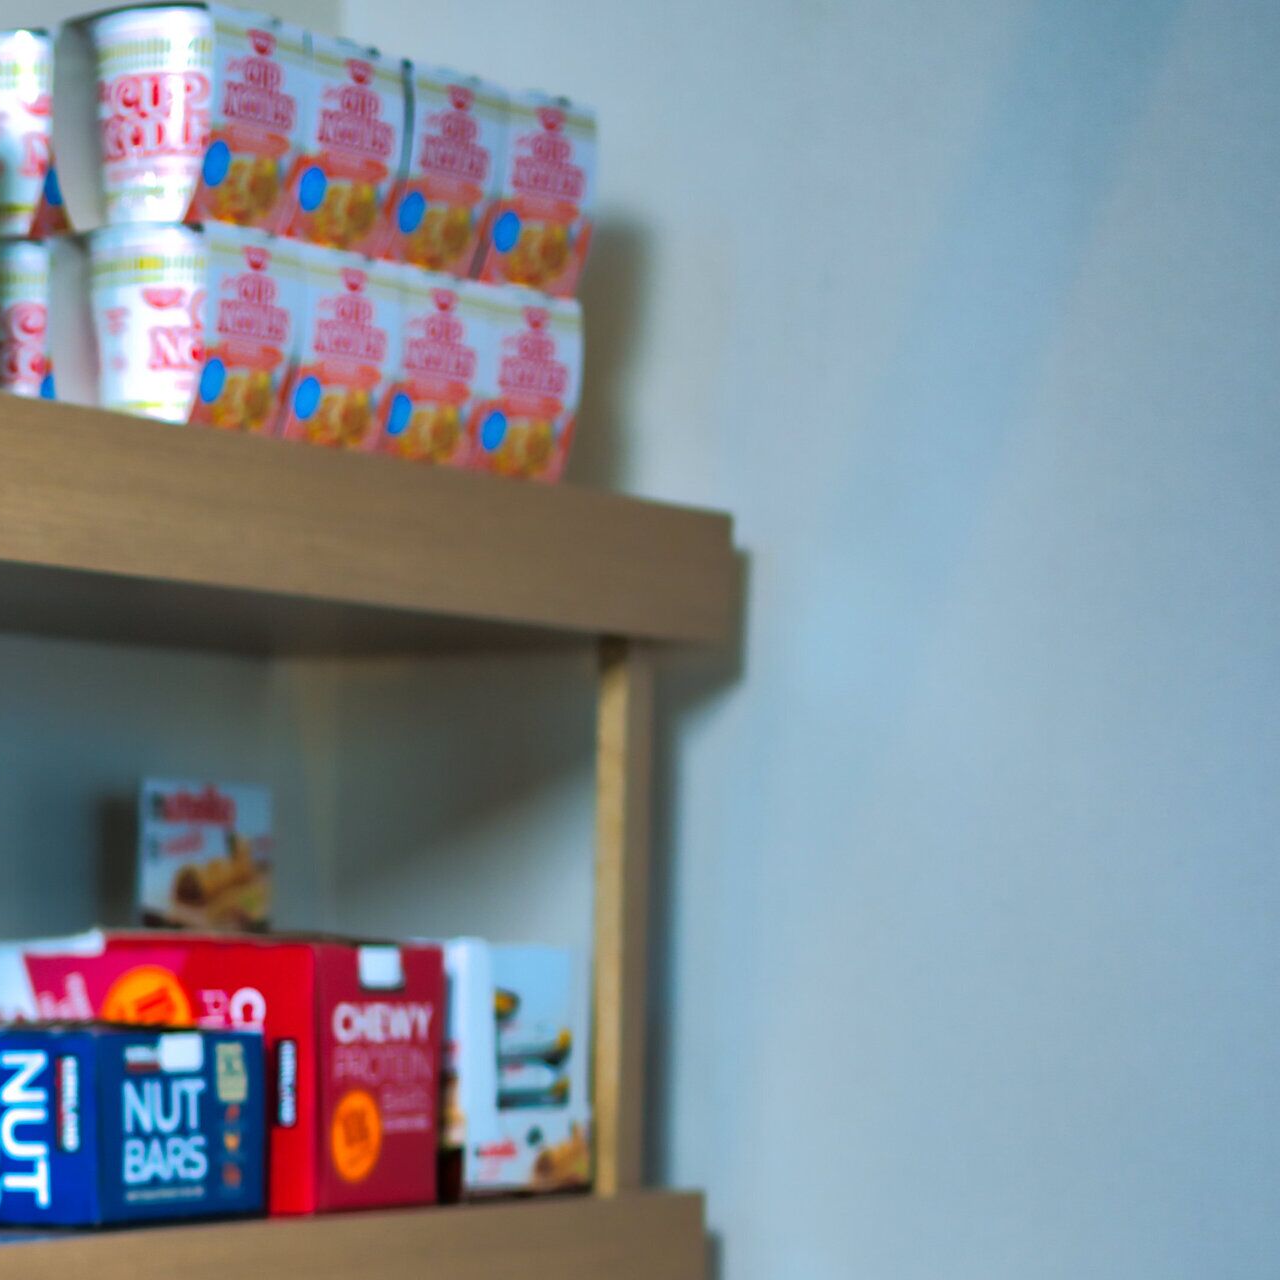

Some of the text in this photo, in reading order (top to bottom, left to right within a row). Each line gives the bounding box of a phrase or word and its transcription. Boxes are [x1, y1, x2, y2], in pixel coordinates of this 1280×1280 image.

[332, 1003, 435, 1043] CHEWY
[333, 1046, 433, 1082] PROTEIN
[0, 1051, 49, 1207] NUT
[123, 1078, 206, 1134] NUT
[123, 1137, 208, 1184] BARS
